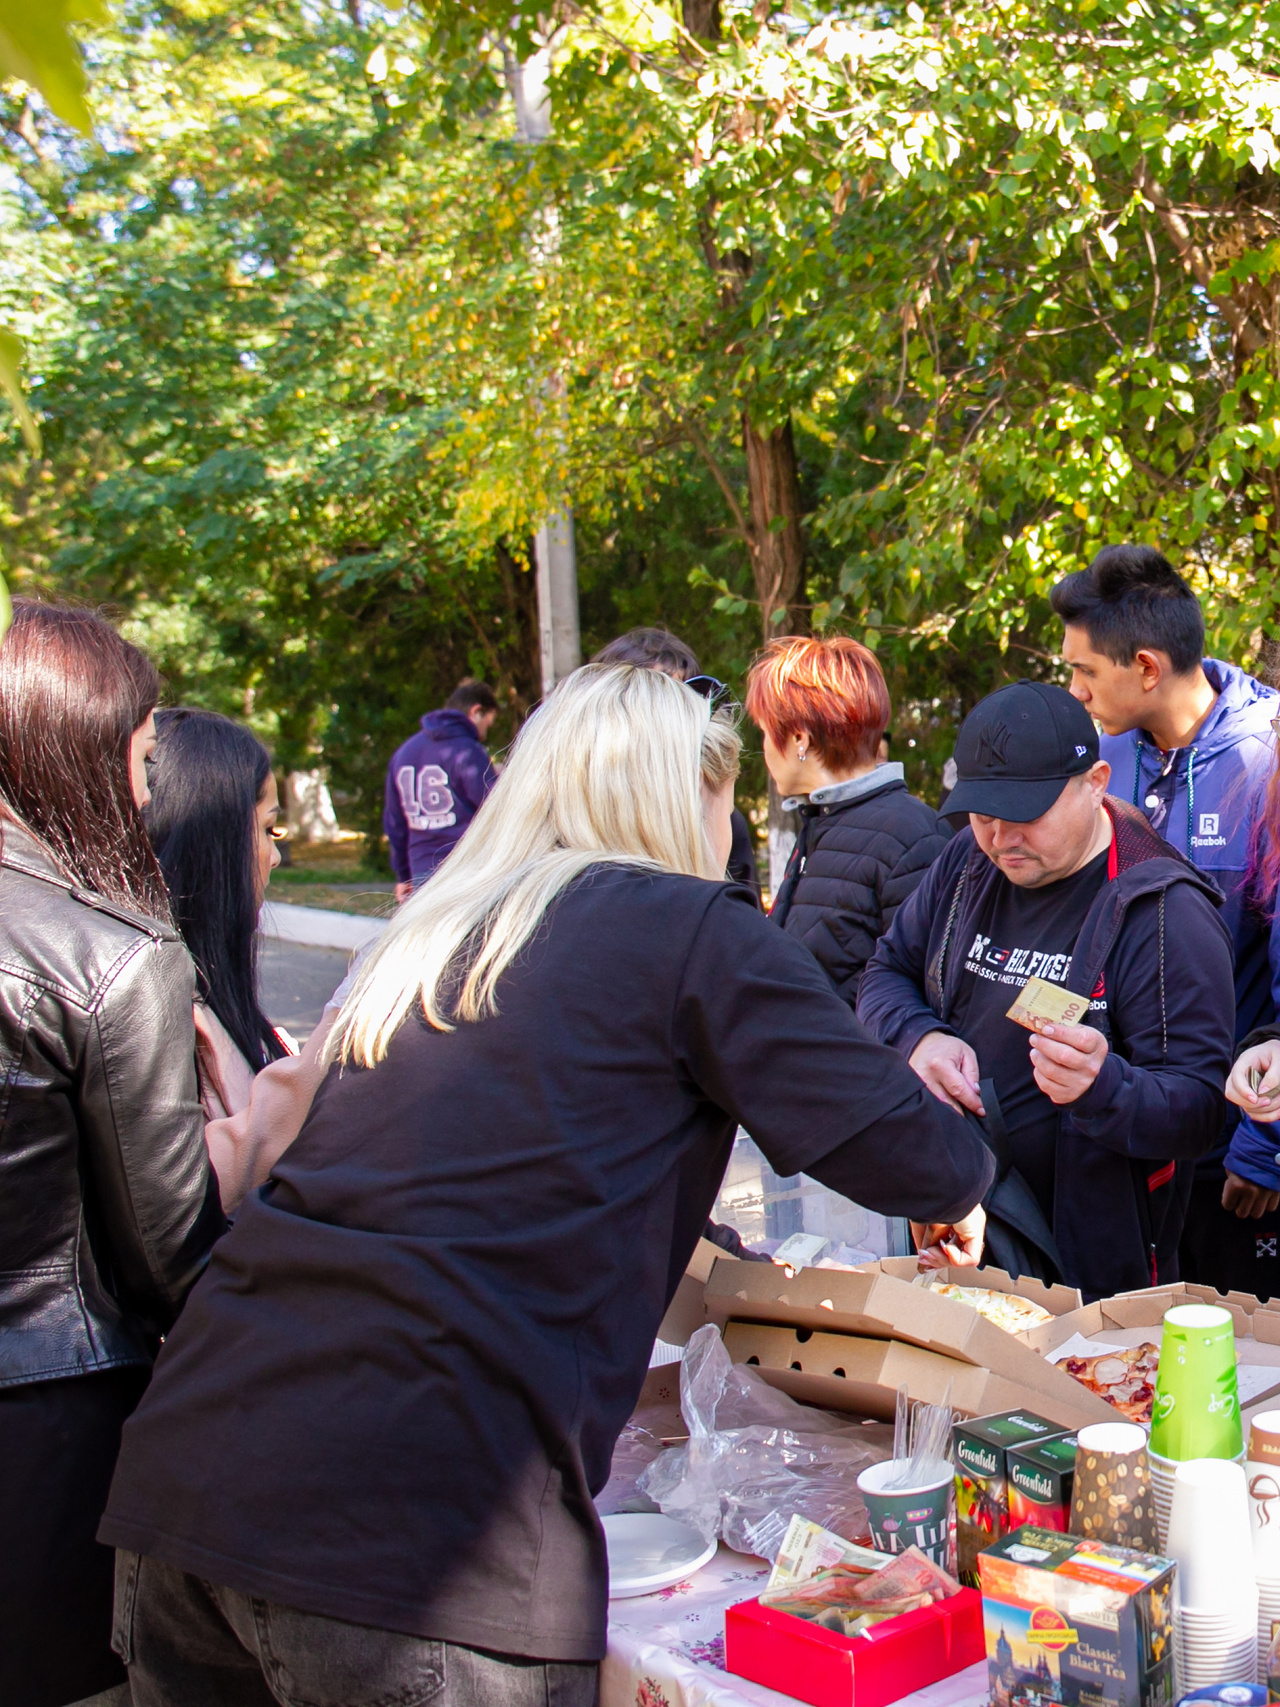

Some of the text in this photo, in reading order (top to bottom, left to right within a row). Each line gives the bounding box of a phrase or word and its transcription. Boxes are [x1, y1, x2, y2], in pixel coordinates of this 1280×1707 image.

[397, 765, 454, 816] 16
[1190, 836, 1227, 847] Reebok
[1061, 1003, 1080, 1022] 100
[957, 1439, 997, 1473] Greenfield
[1012, 1464, 1053, 1499] Greenfield
[1076, 1641, 1117, 1662] Classic
[1069, 1653, 1127, 1680] Black Tea
